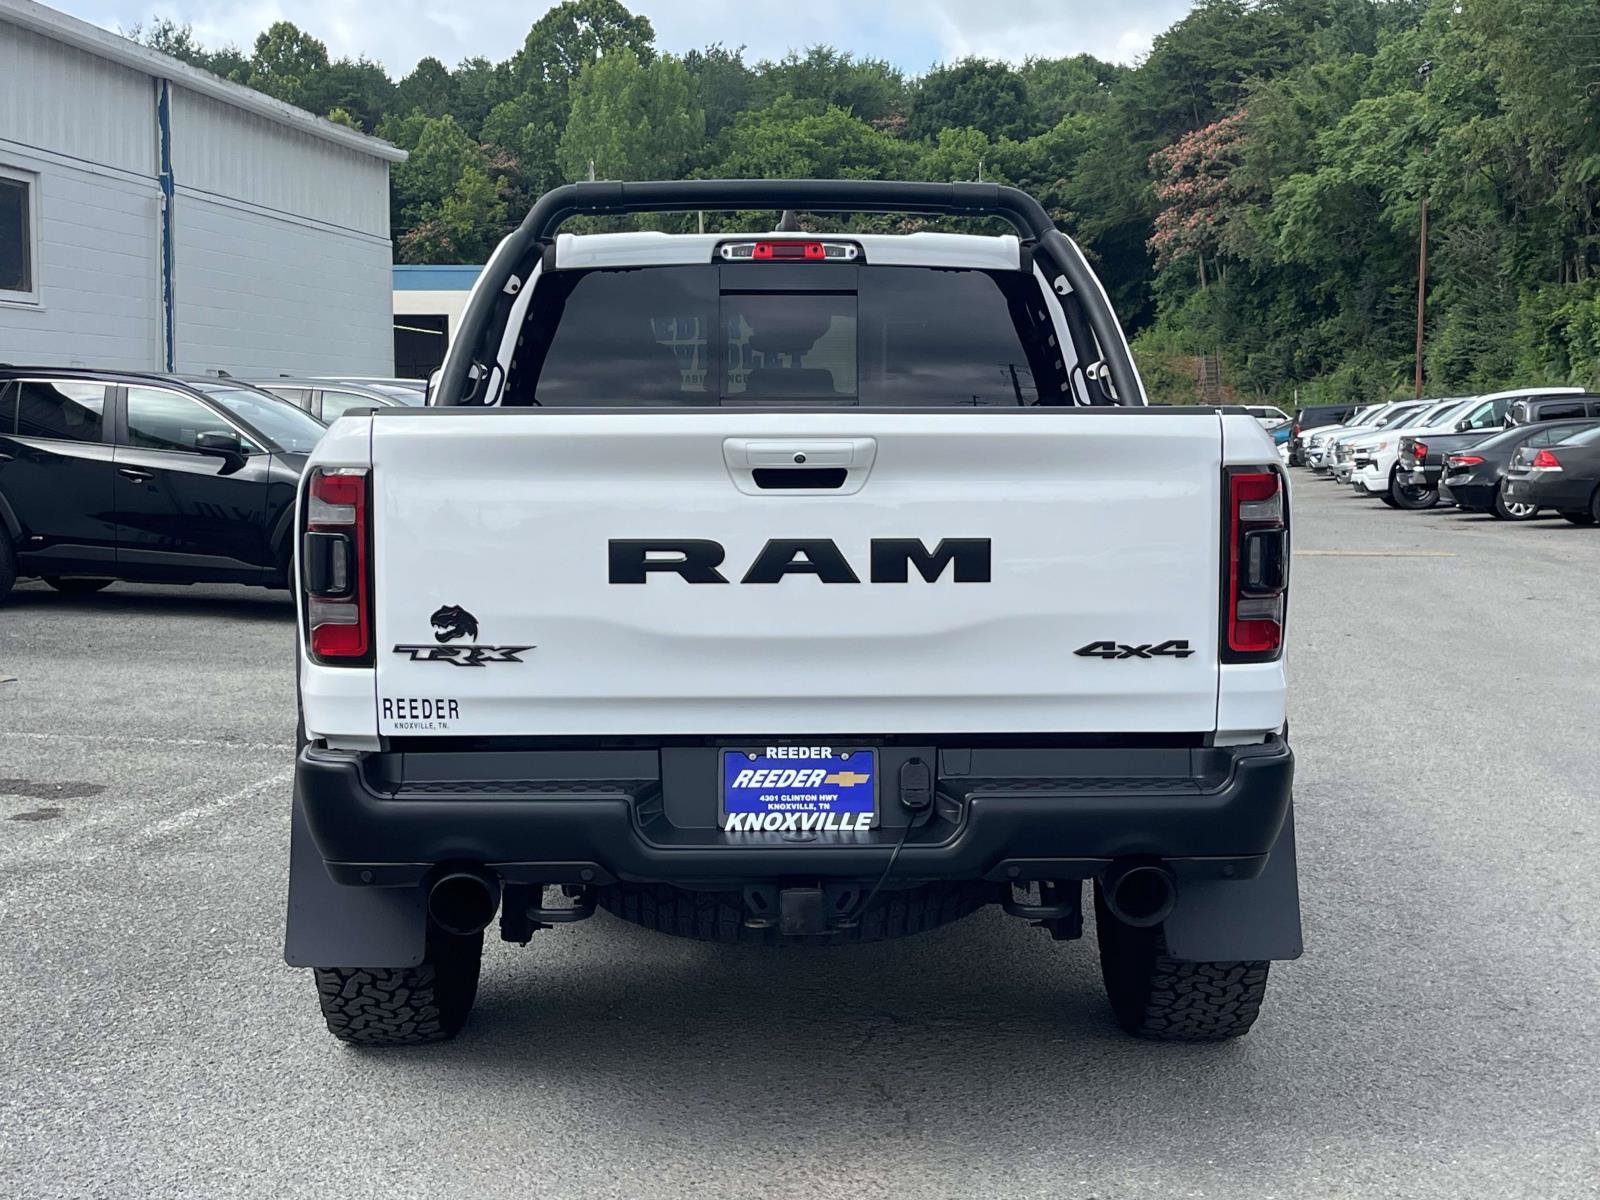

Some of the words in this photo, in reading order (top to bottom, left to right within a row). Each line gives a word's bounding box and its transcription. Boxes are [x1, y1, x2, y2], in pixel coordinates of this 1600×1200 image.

[609, 538, 992, 584] RAM
[392, 643, 537, 667] TRX
[1073, 640, 1196, 659] 4x4
[382, 698, 460, 719] REEDER
[766, 746, 832, 759] REEDER
[732, 769, 827, 788] REEDER
[759, 794, 779, 802] 4301
[781, 794, 818, 802] CLINTON
[819, 794, 839, 802] HWY
[767, 803, 817, 811] KNOXVILLE,
[724, 812, 874, 831] KNOXVILLE
